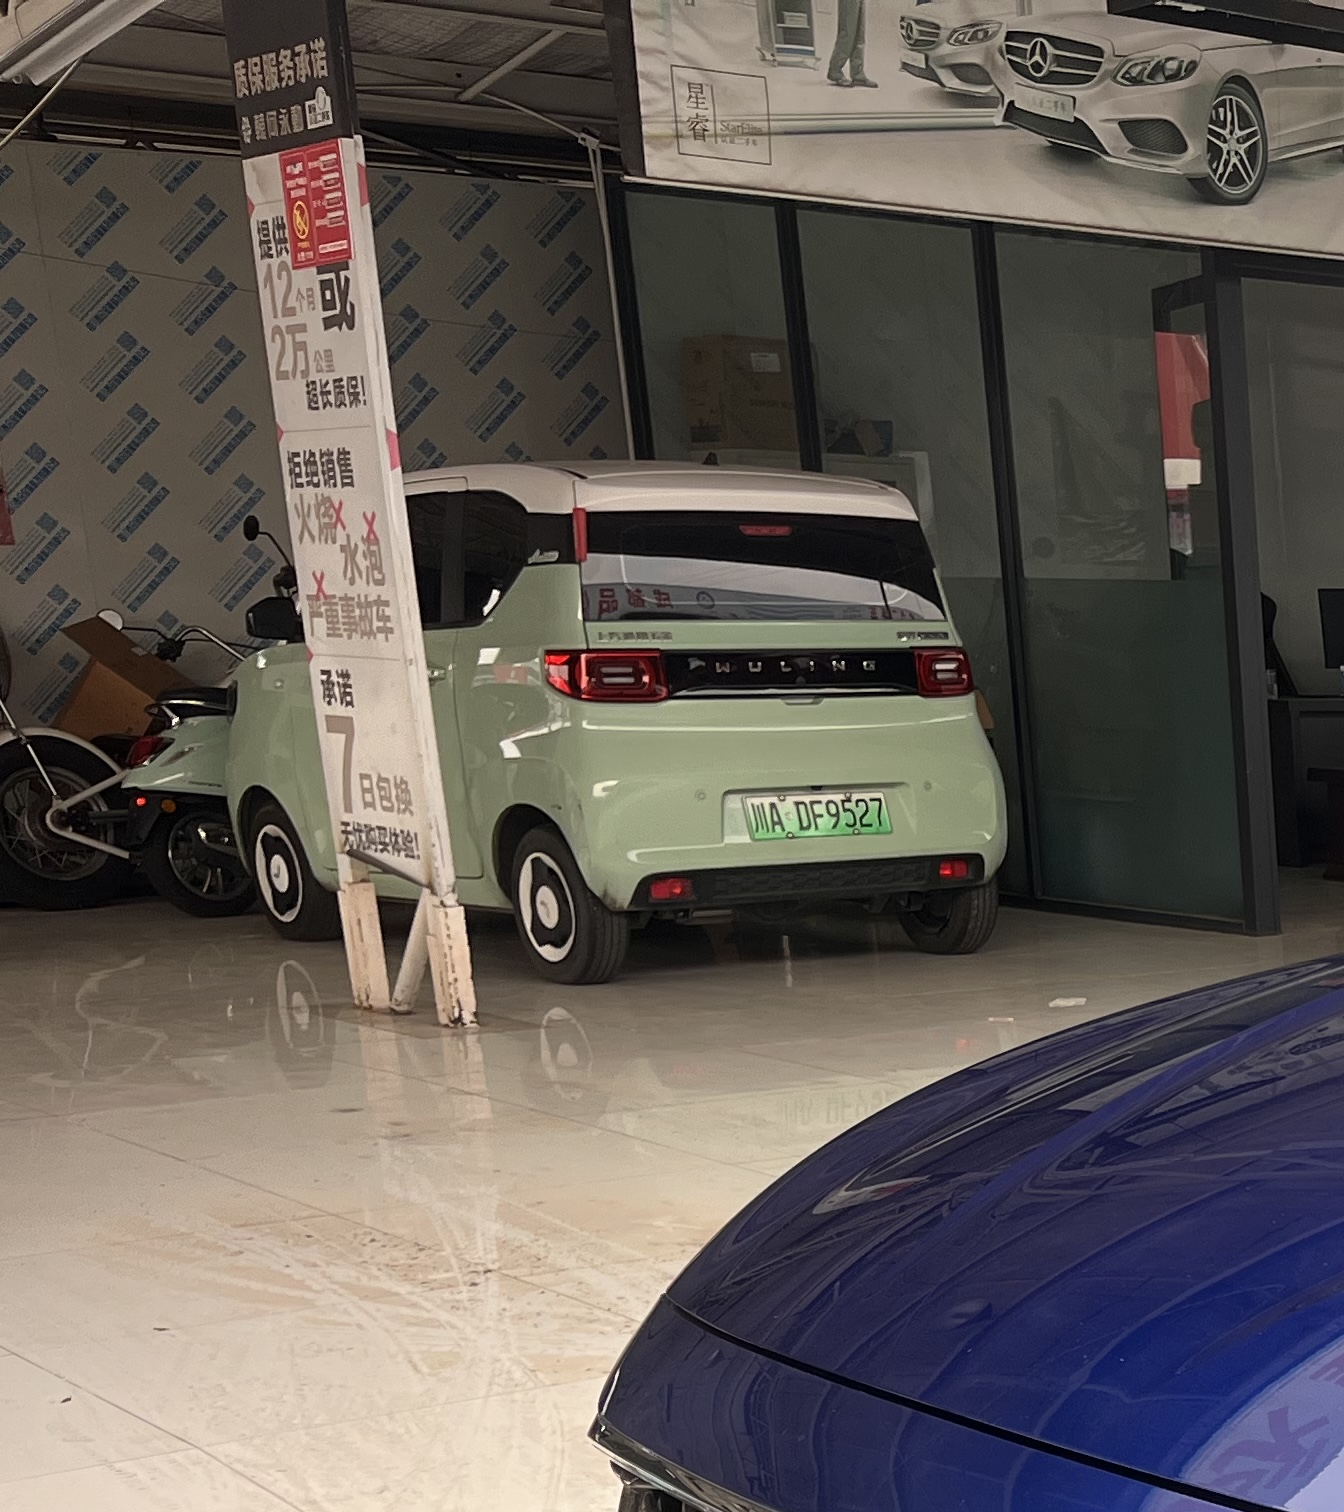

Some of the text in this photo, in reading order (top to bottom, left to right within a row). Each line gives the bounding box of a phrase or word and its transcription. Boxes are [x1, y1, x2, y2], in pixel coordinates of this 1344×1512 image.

[232, 36, 329, 99] 质保服务承诺
[685, 81, 711, 143] 星睿
[256, 215, 290, 261] 提供
[286, 446, 356, 492] 拒绝销售
[715, 659, 877, 673] WULING
[318, 669, 355, 710] 承诺
